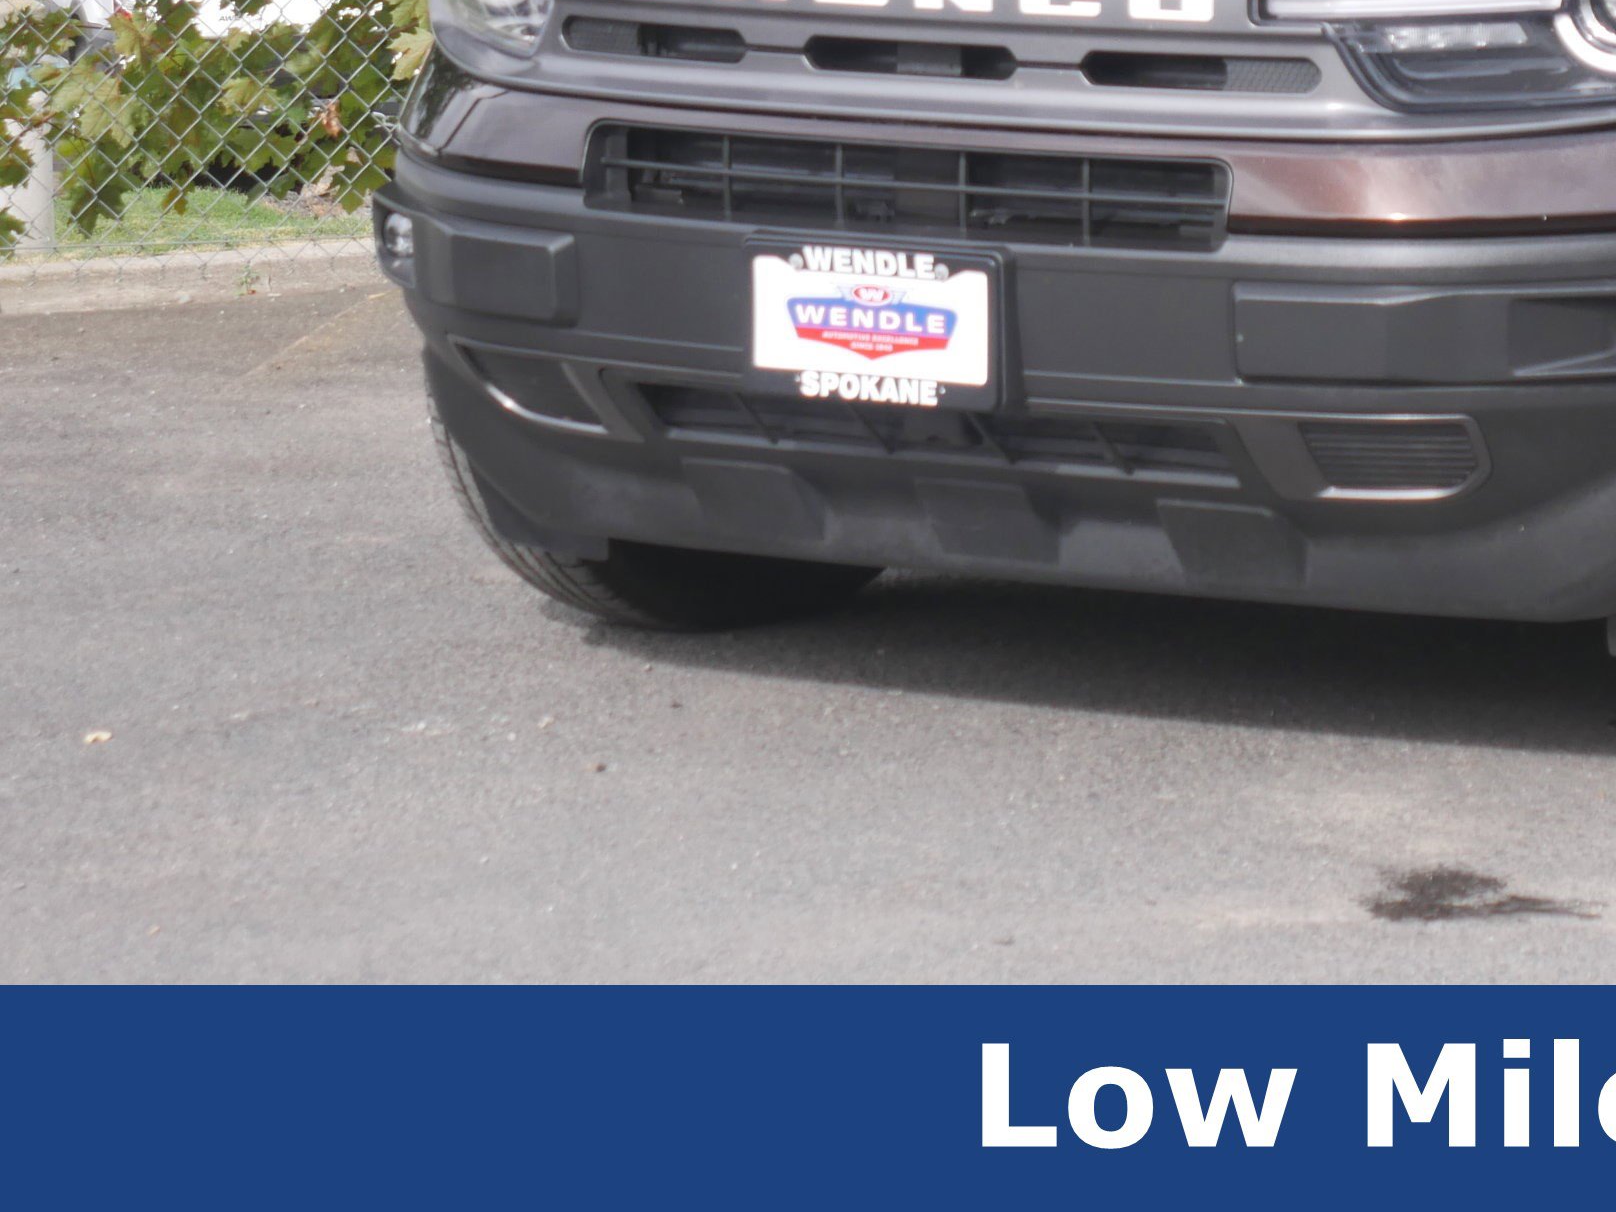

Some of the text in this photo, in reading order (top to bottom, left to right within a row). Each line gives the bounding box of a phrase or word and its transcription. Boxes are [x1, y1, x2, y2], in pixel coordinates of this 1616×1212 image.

[802, 244, 935, 279] WENDLE
[795, 304, 945, 334] WENDLE
[800, 370, 938, 406] SPOKANE
